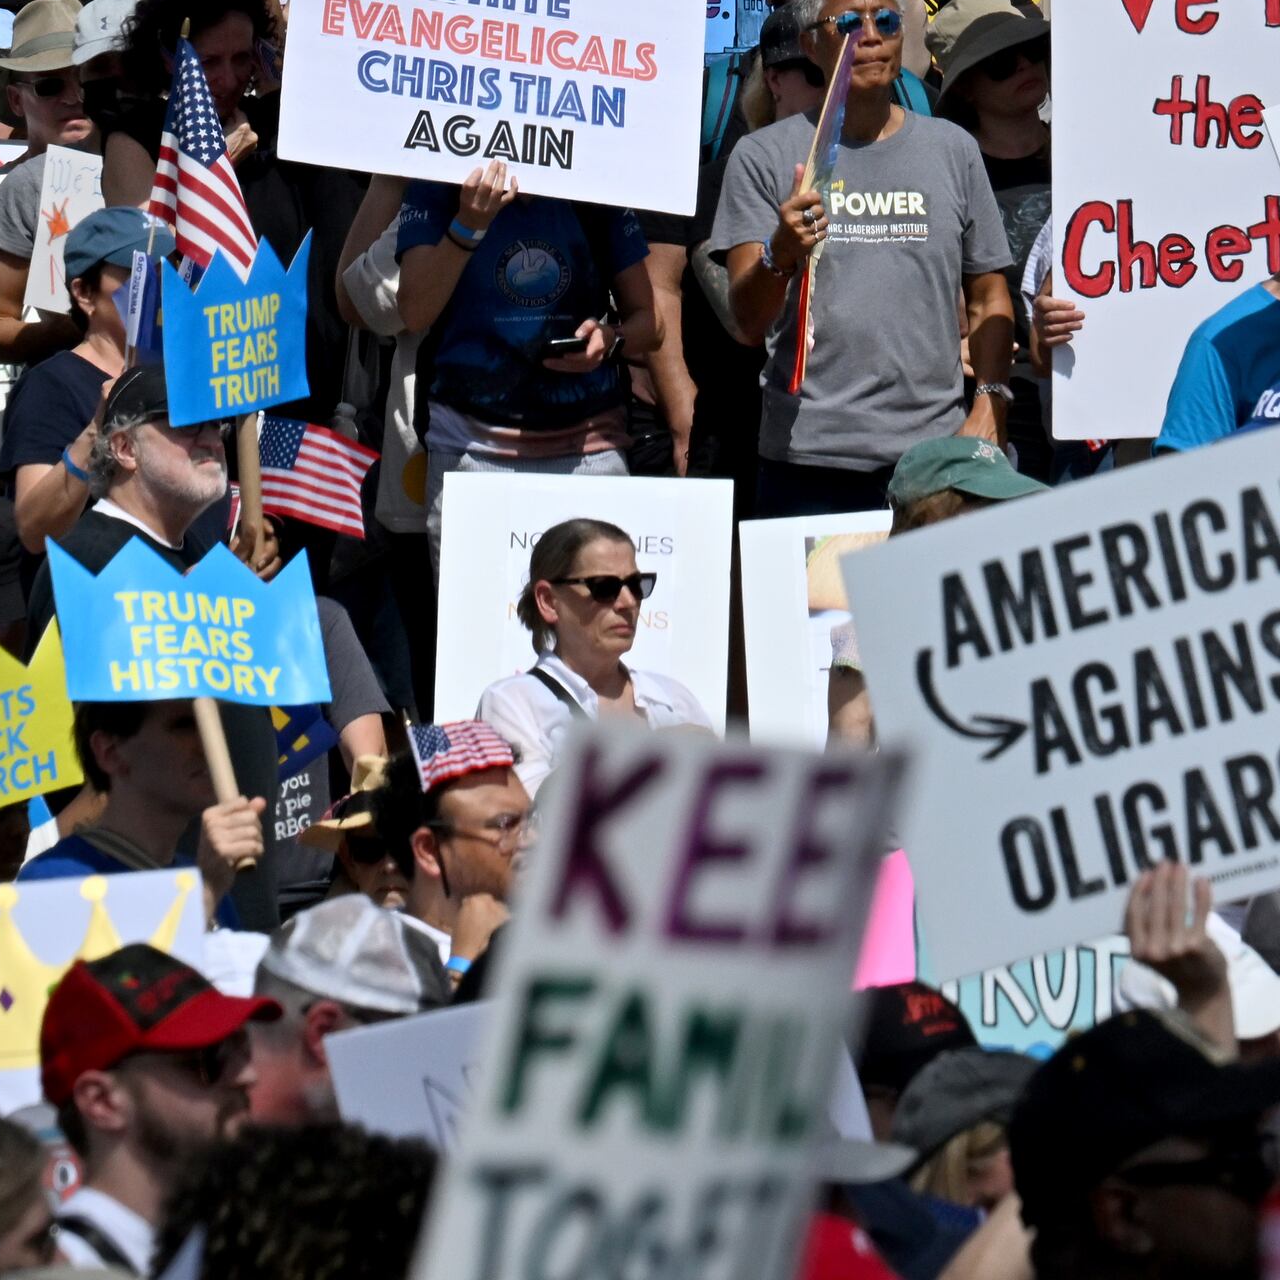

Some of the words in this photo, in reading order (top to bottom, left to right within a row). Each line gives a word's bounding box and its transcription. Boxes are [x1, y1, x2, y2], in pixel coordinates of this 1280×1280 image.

[357, 50, 625, 128] CHRISTIAN
[1153, 74, 1265, 150] the
[404, 109, 575, 170] AGAIN
[830, 191, 927, 216] POWER
[844, 224, 888, 235] LEADERSHIP
[890, 223, 928, 234] INSTITUTE
[203, 293, 281, 339] TRUMP
[210, 327, 278, 370] FEARS
[208, 364, 280, 409] TRUTH
[114, 590, 255, 628] TRUMP
[129, 623, 253, 663] FEARS
[109, 658, 281, 699] HISTORY
